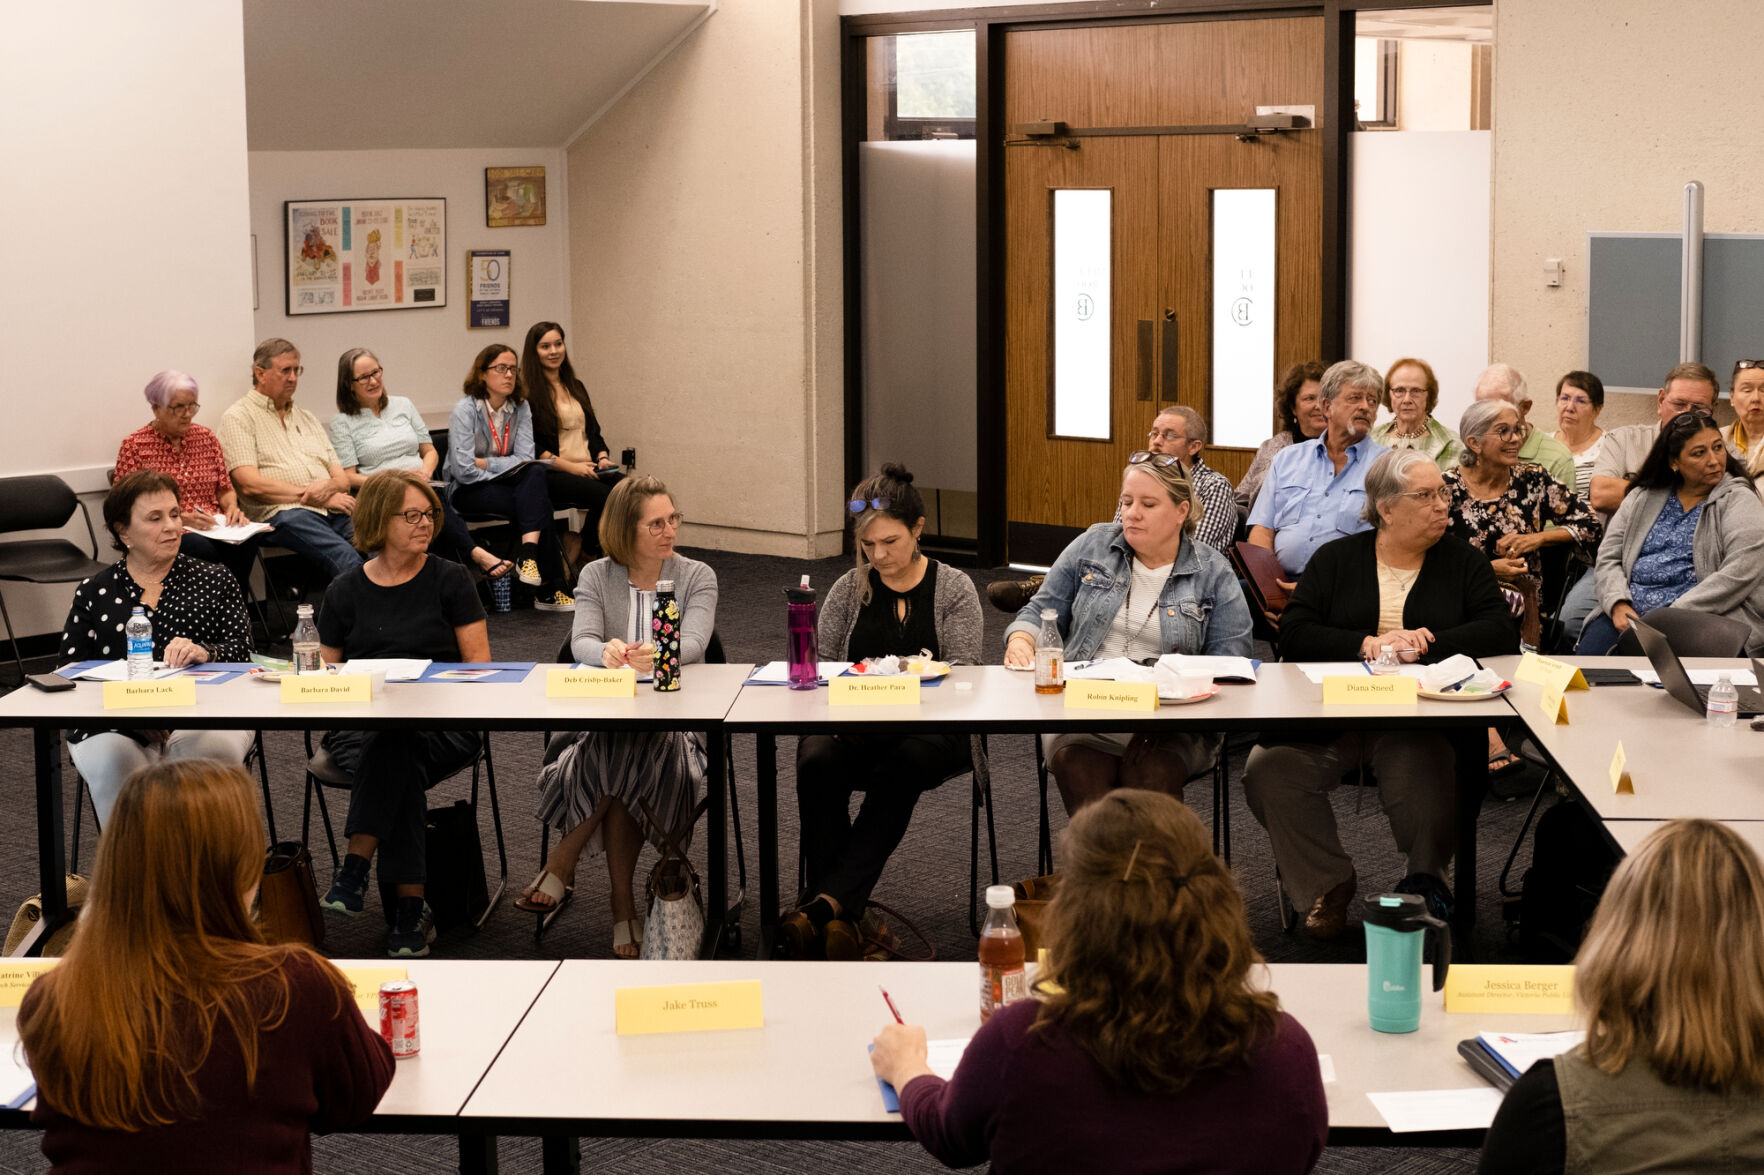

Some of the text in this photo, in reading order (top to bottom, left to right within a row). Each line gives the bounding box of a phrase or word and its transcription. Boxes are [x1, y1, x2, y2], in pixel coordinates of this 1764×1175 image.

[320, 217, 338, 226] BOOK
[320, 228, 337, 237] SALE
[480, 259, 501, 281] 50
[126, 687, 155, 695] Barbara
[1346, 684, 1394, 692] Diana Sneed
[1087, 693, 1138, 703] Robin Knipling
[0, 971, 25, 979] atrine
[1483, 980, 1559, 991] Jessica Berger
[662, 999, 718, 1011] Jake Truss
